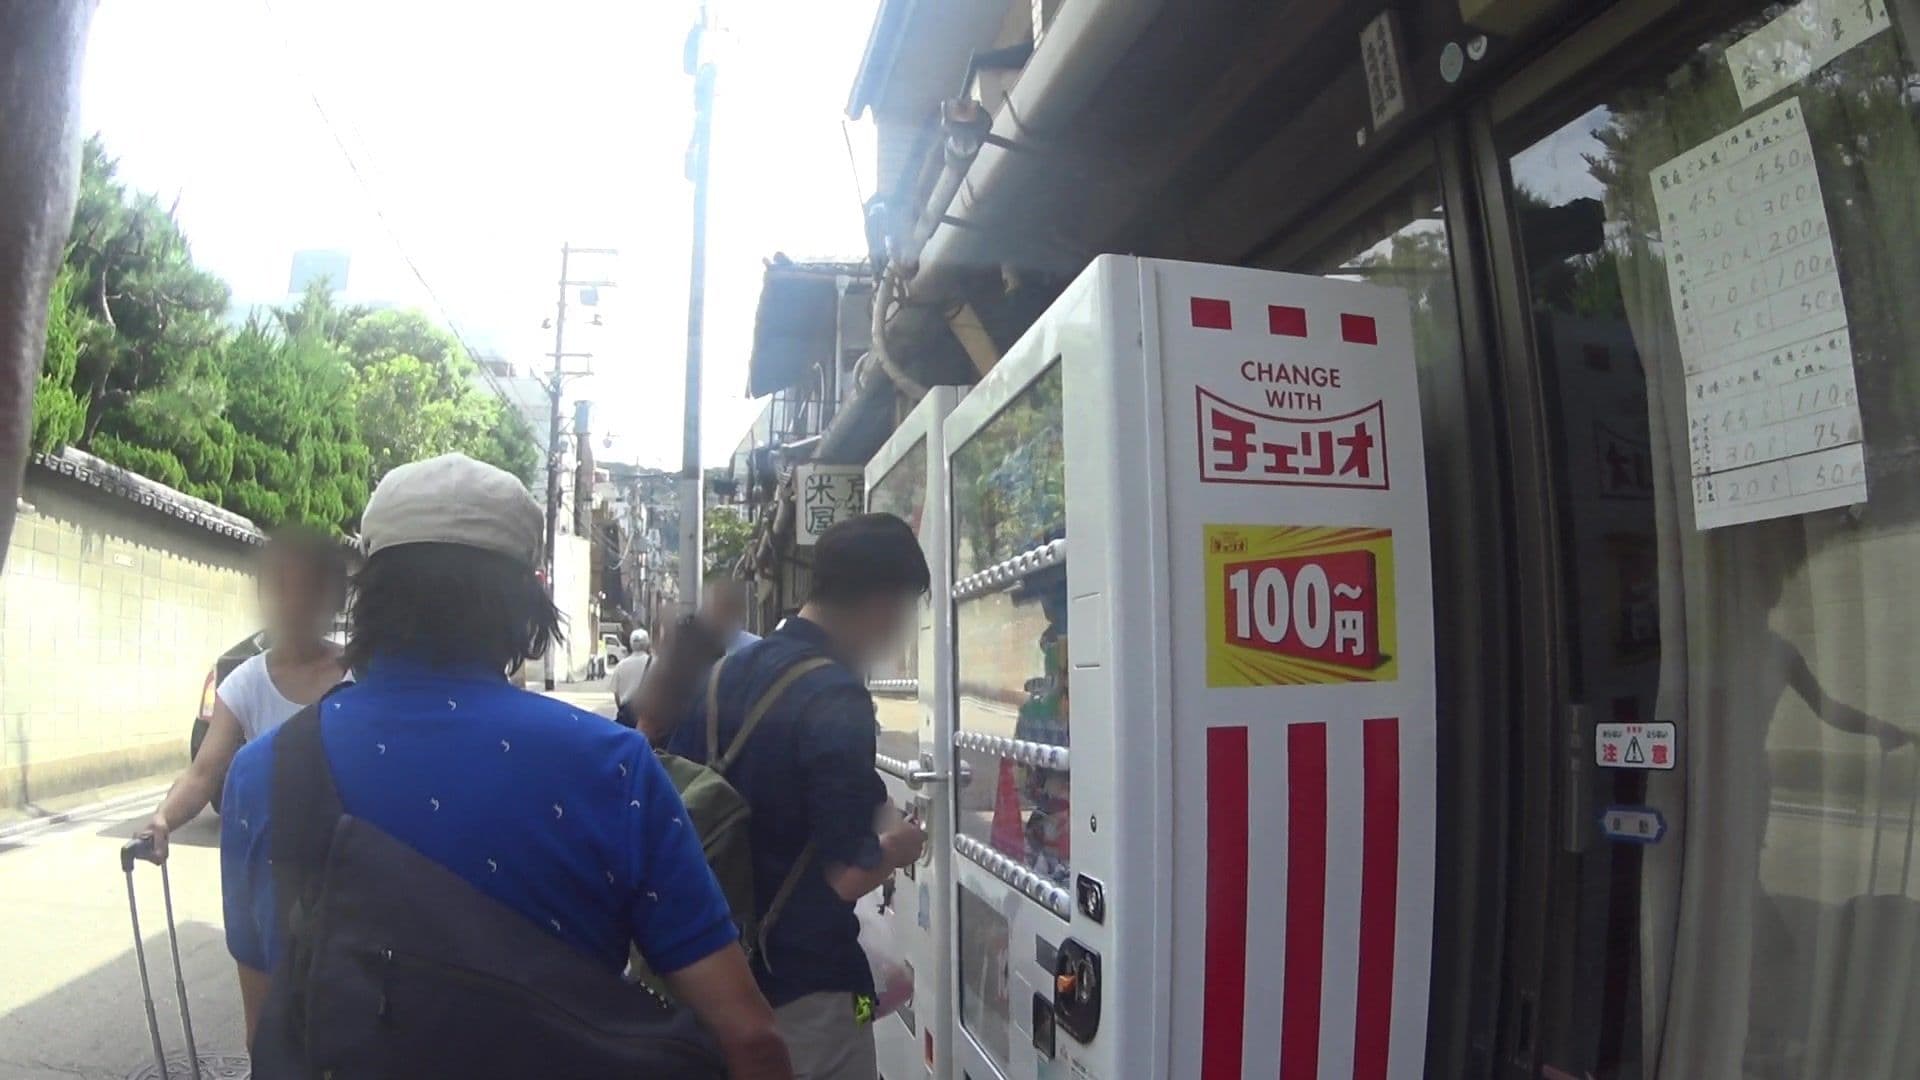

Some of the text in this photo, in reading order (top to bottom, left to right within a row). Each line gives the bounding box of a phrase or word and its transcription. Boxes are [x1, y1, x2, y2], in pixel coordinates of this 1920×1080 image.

[1241, 360, 1341, 388] CHANGE
[1265, 389, 1322, 412] WITH
[1211, 407, 1375, 478] チェリオ
